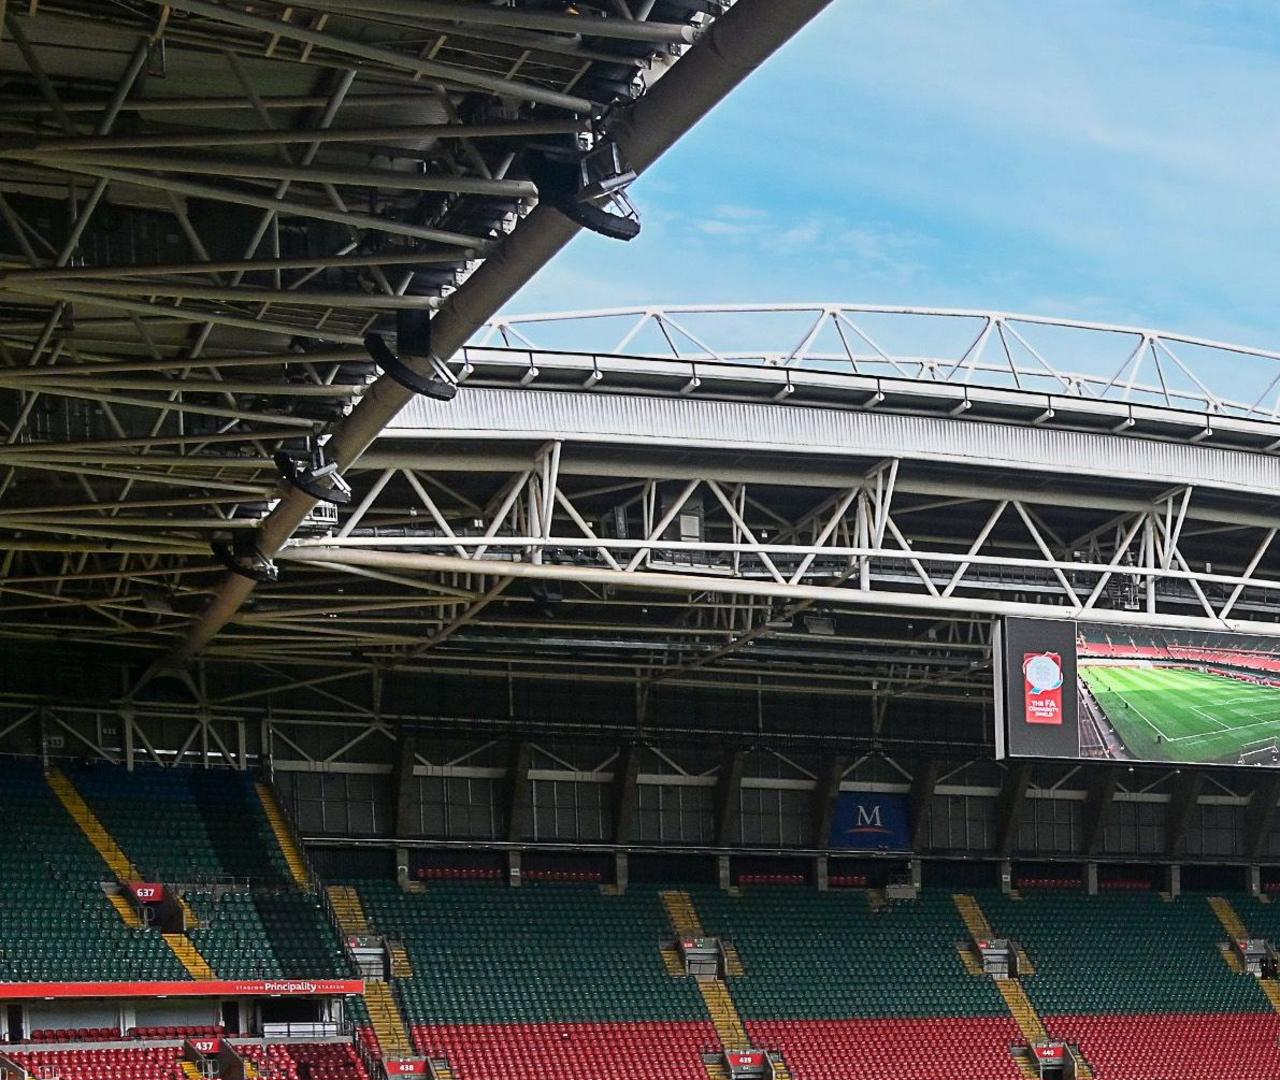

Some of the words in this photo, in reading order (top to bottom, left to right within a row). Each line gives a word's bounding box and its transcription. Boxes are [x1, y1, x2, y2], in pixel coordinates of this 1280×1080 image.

[1045, 700, 1056, 708] FA
[856, 805, 882, 826] M
[137, 888, 154, 897] 637
[265, 982, 317, 993] Principality
[196, 1042, 213, 1051] 437
